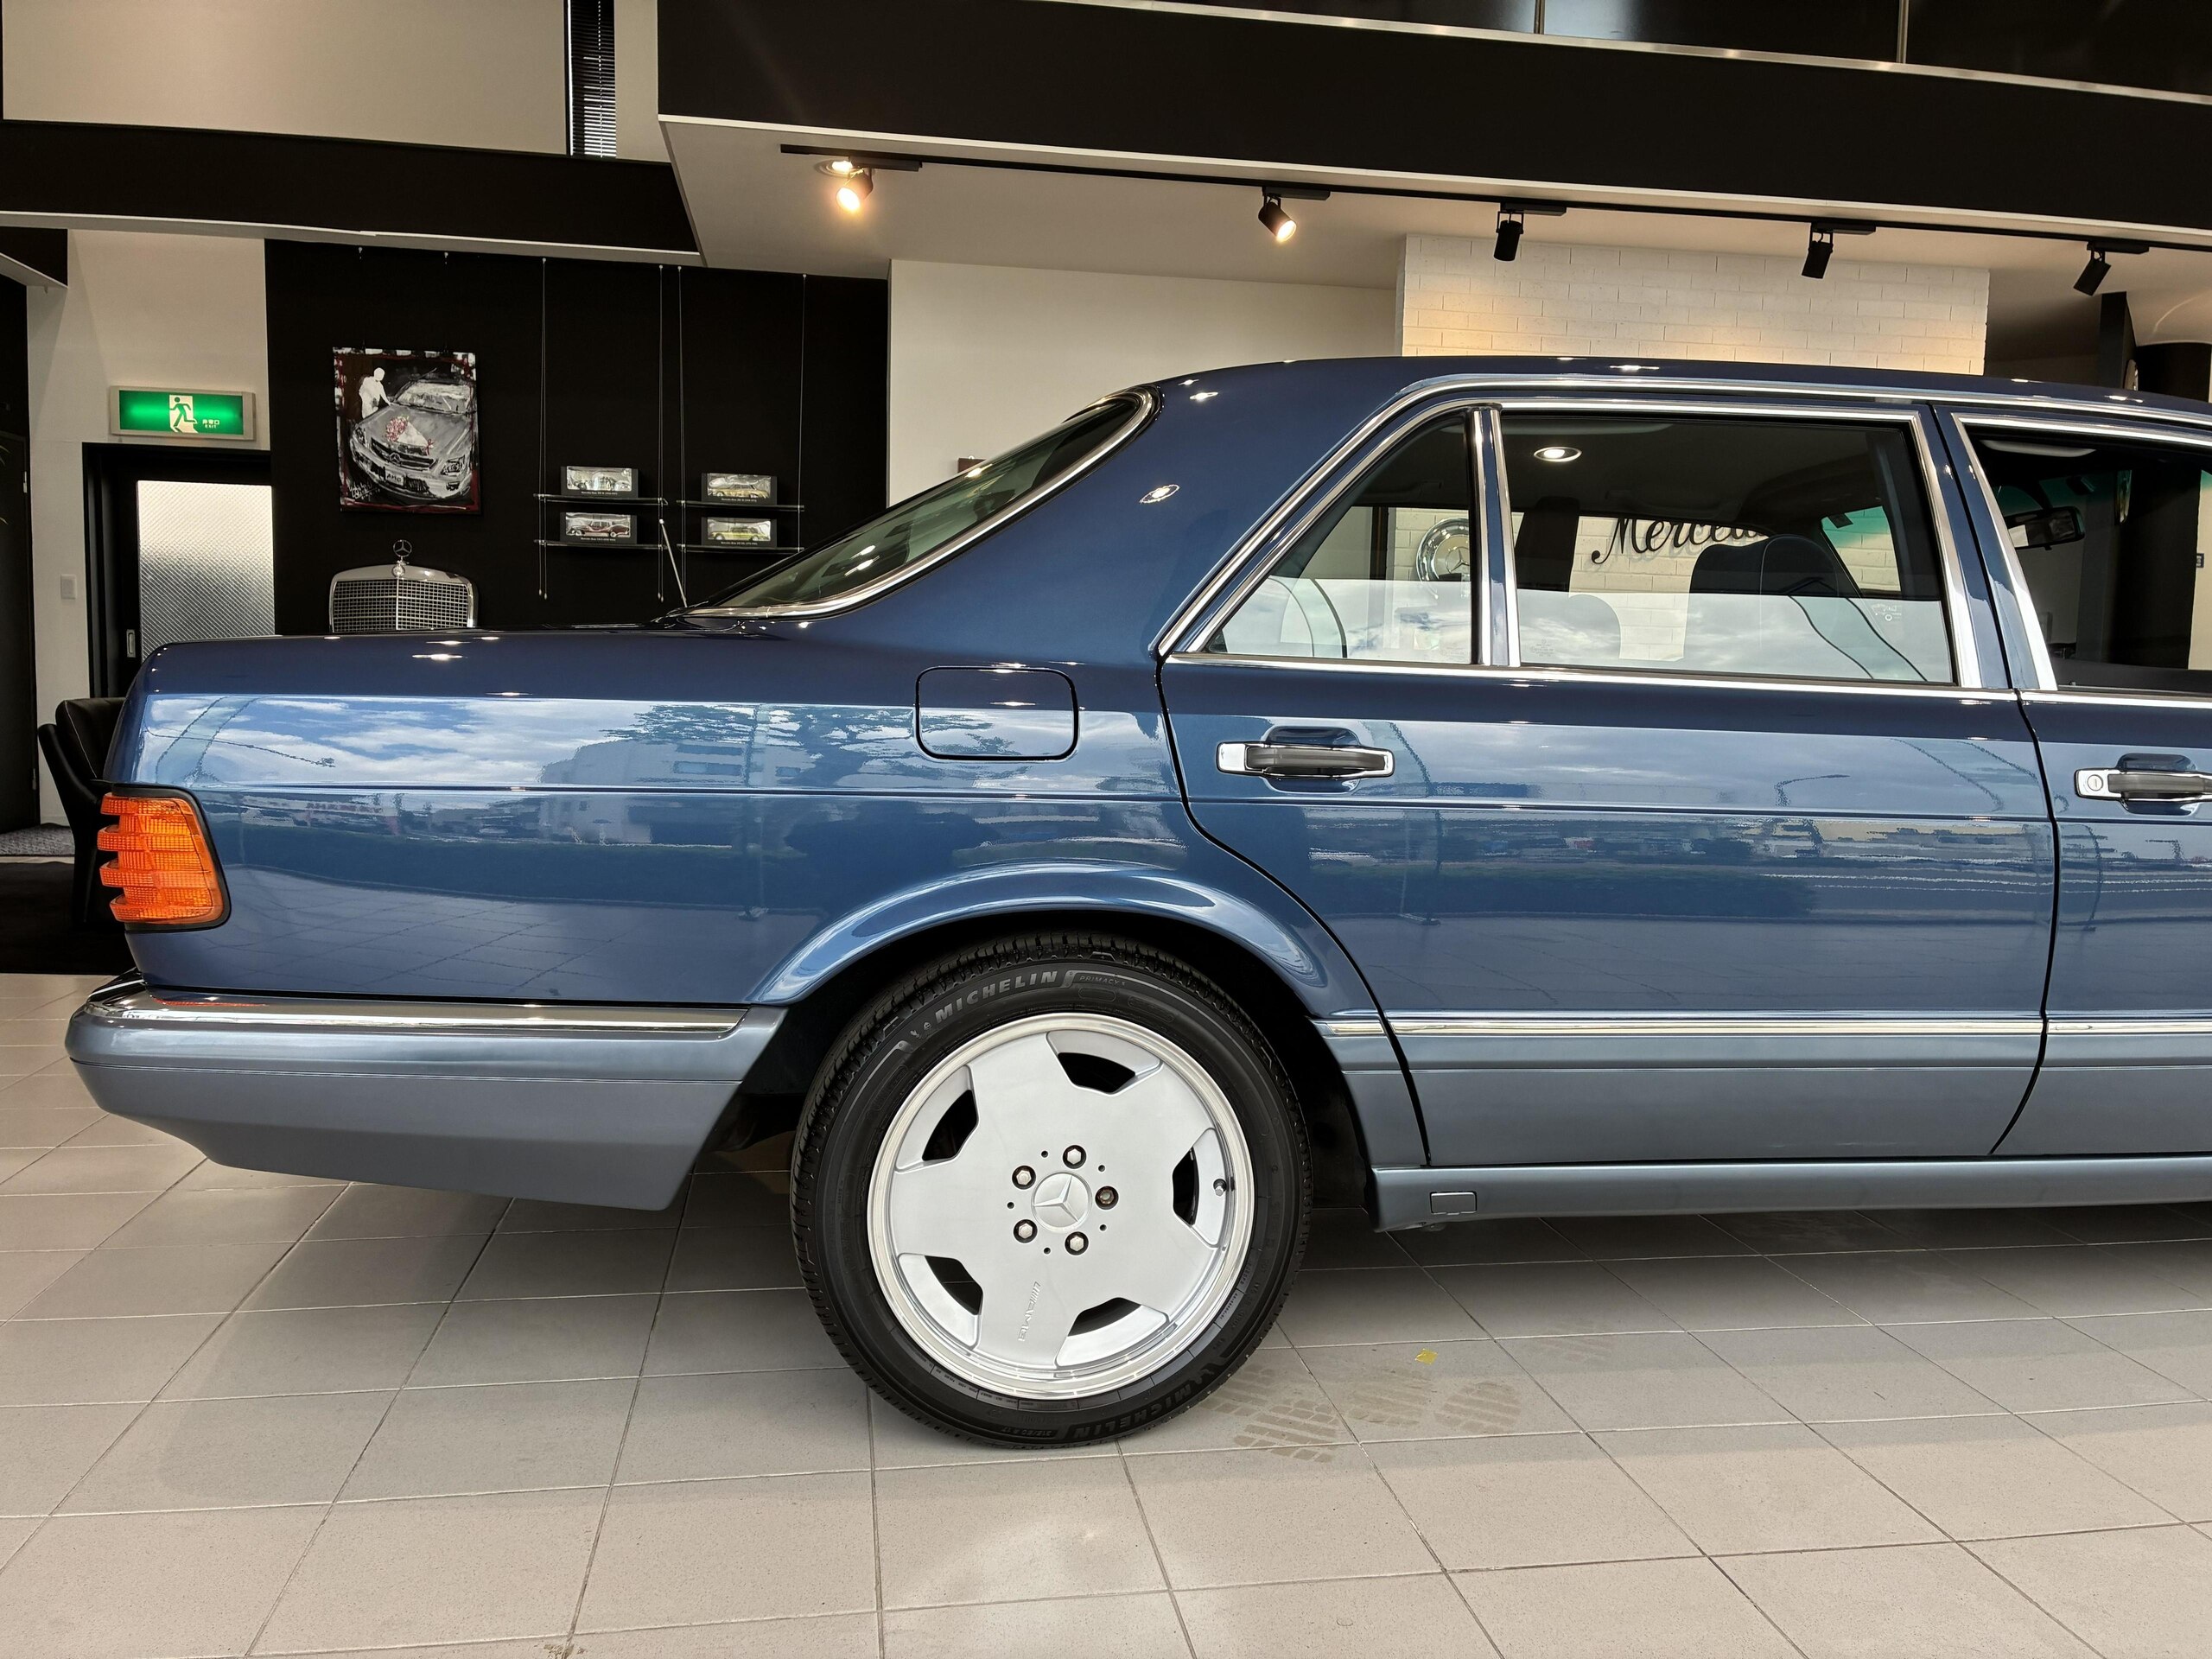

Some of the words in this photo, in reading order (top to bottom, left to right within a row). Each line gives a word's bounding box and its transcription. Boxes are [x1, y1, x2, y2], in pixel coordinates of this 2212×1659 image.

[386, 473, 402, 482] AMG
[935, 970, 1058, 1023] MICHELIN
[1079, 976, 1120, 986] PRIMACY
[1074, 1383, 1192, 1439] MICHELIN
